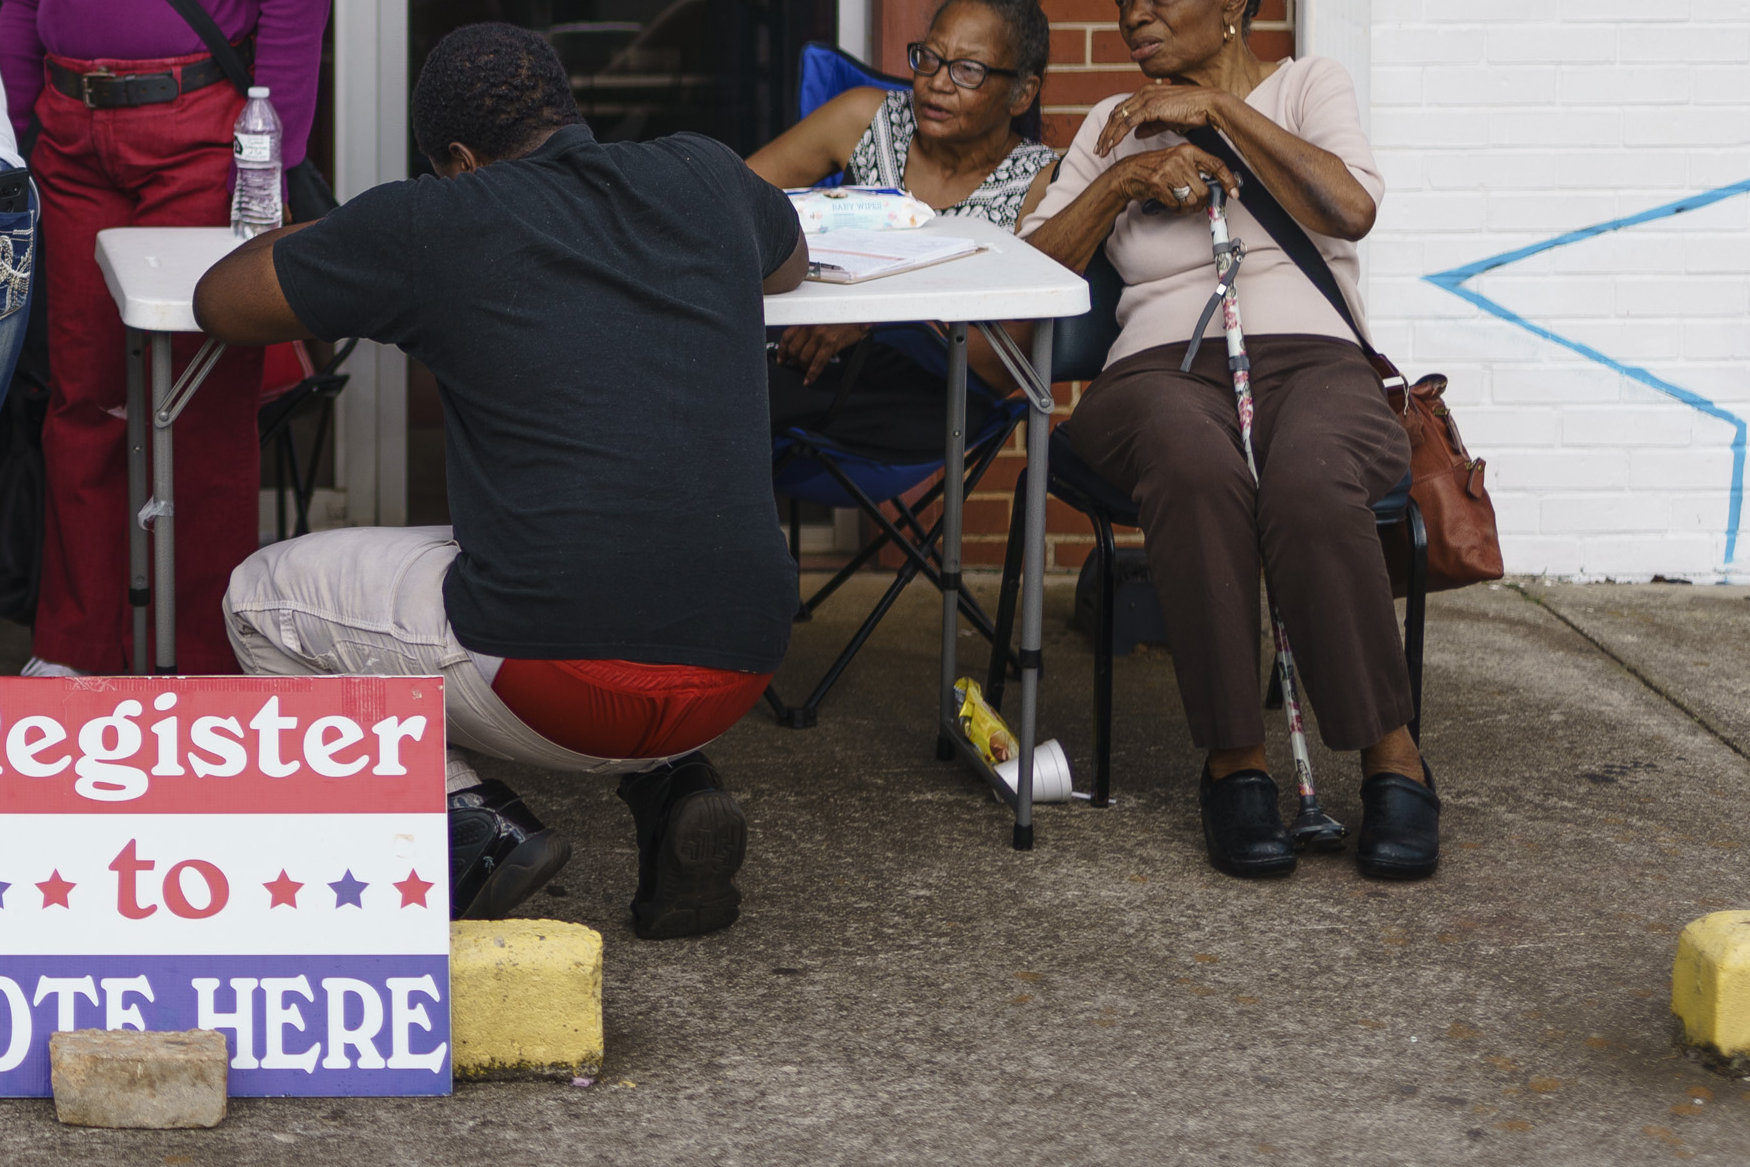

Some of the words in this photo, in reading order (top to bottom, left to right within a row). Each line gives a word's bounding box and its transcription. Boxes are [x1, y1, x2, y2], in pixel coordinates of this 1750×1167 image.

[832, 202, 855, 211] BABY
[856, 201, 882, 210] WIPES
[107, 837, 230, 920] to
[191, 973, 448, 1075] HERE
